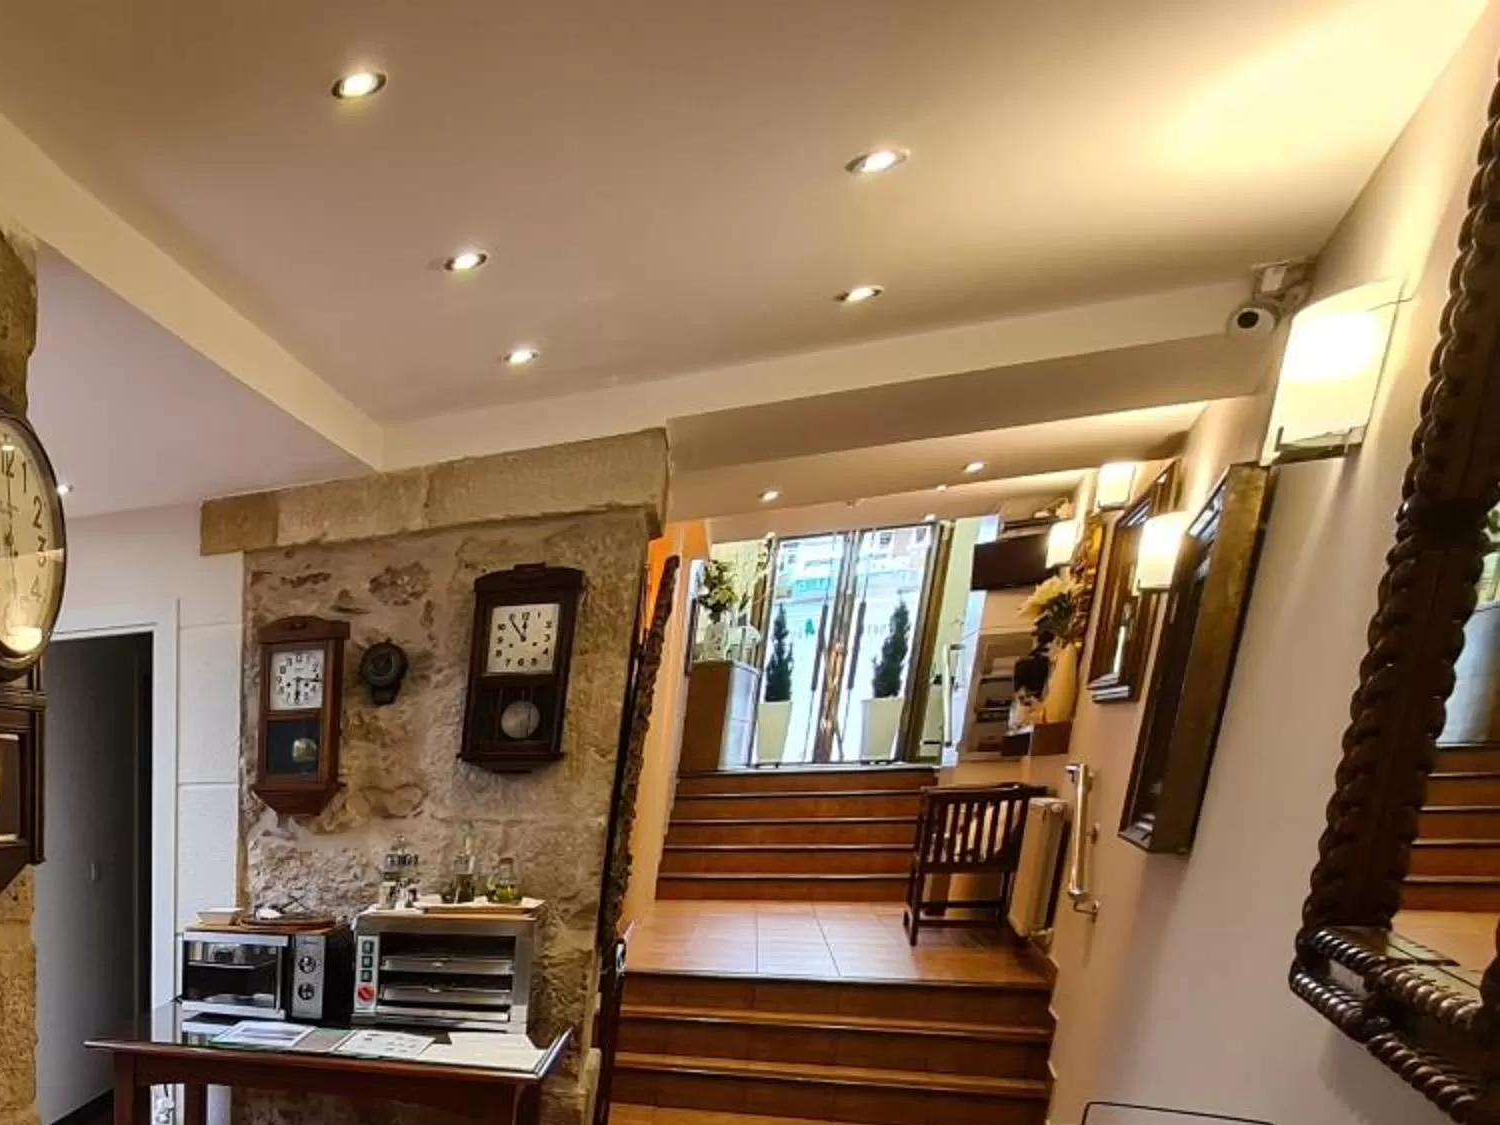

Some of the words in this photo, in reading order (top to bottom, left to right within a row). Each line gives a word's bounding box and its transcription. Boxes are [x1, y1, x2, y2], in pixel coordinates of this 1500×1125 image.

[21, 461, 28, 495] 1
[33, 495, 43, 529] 2
[31, 575, 43, 603] 4
